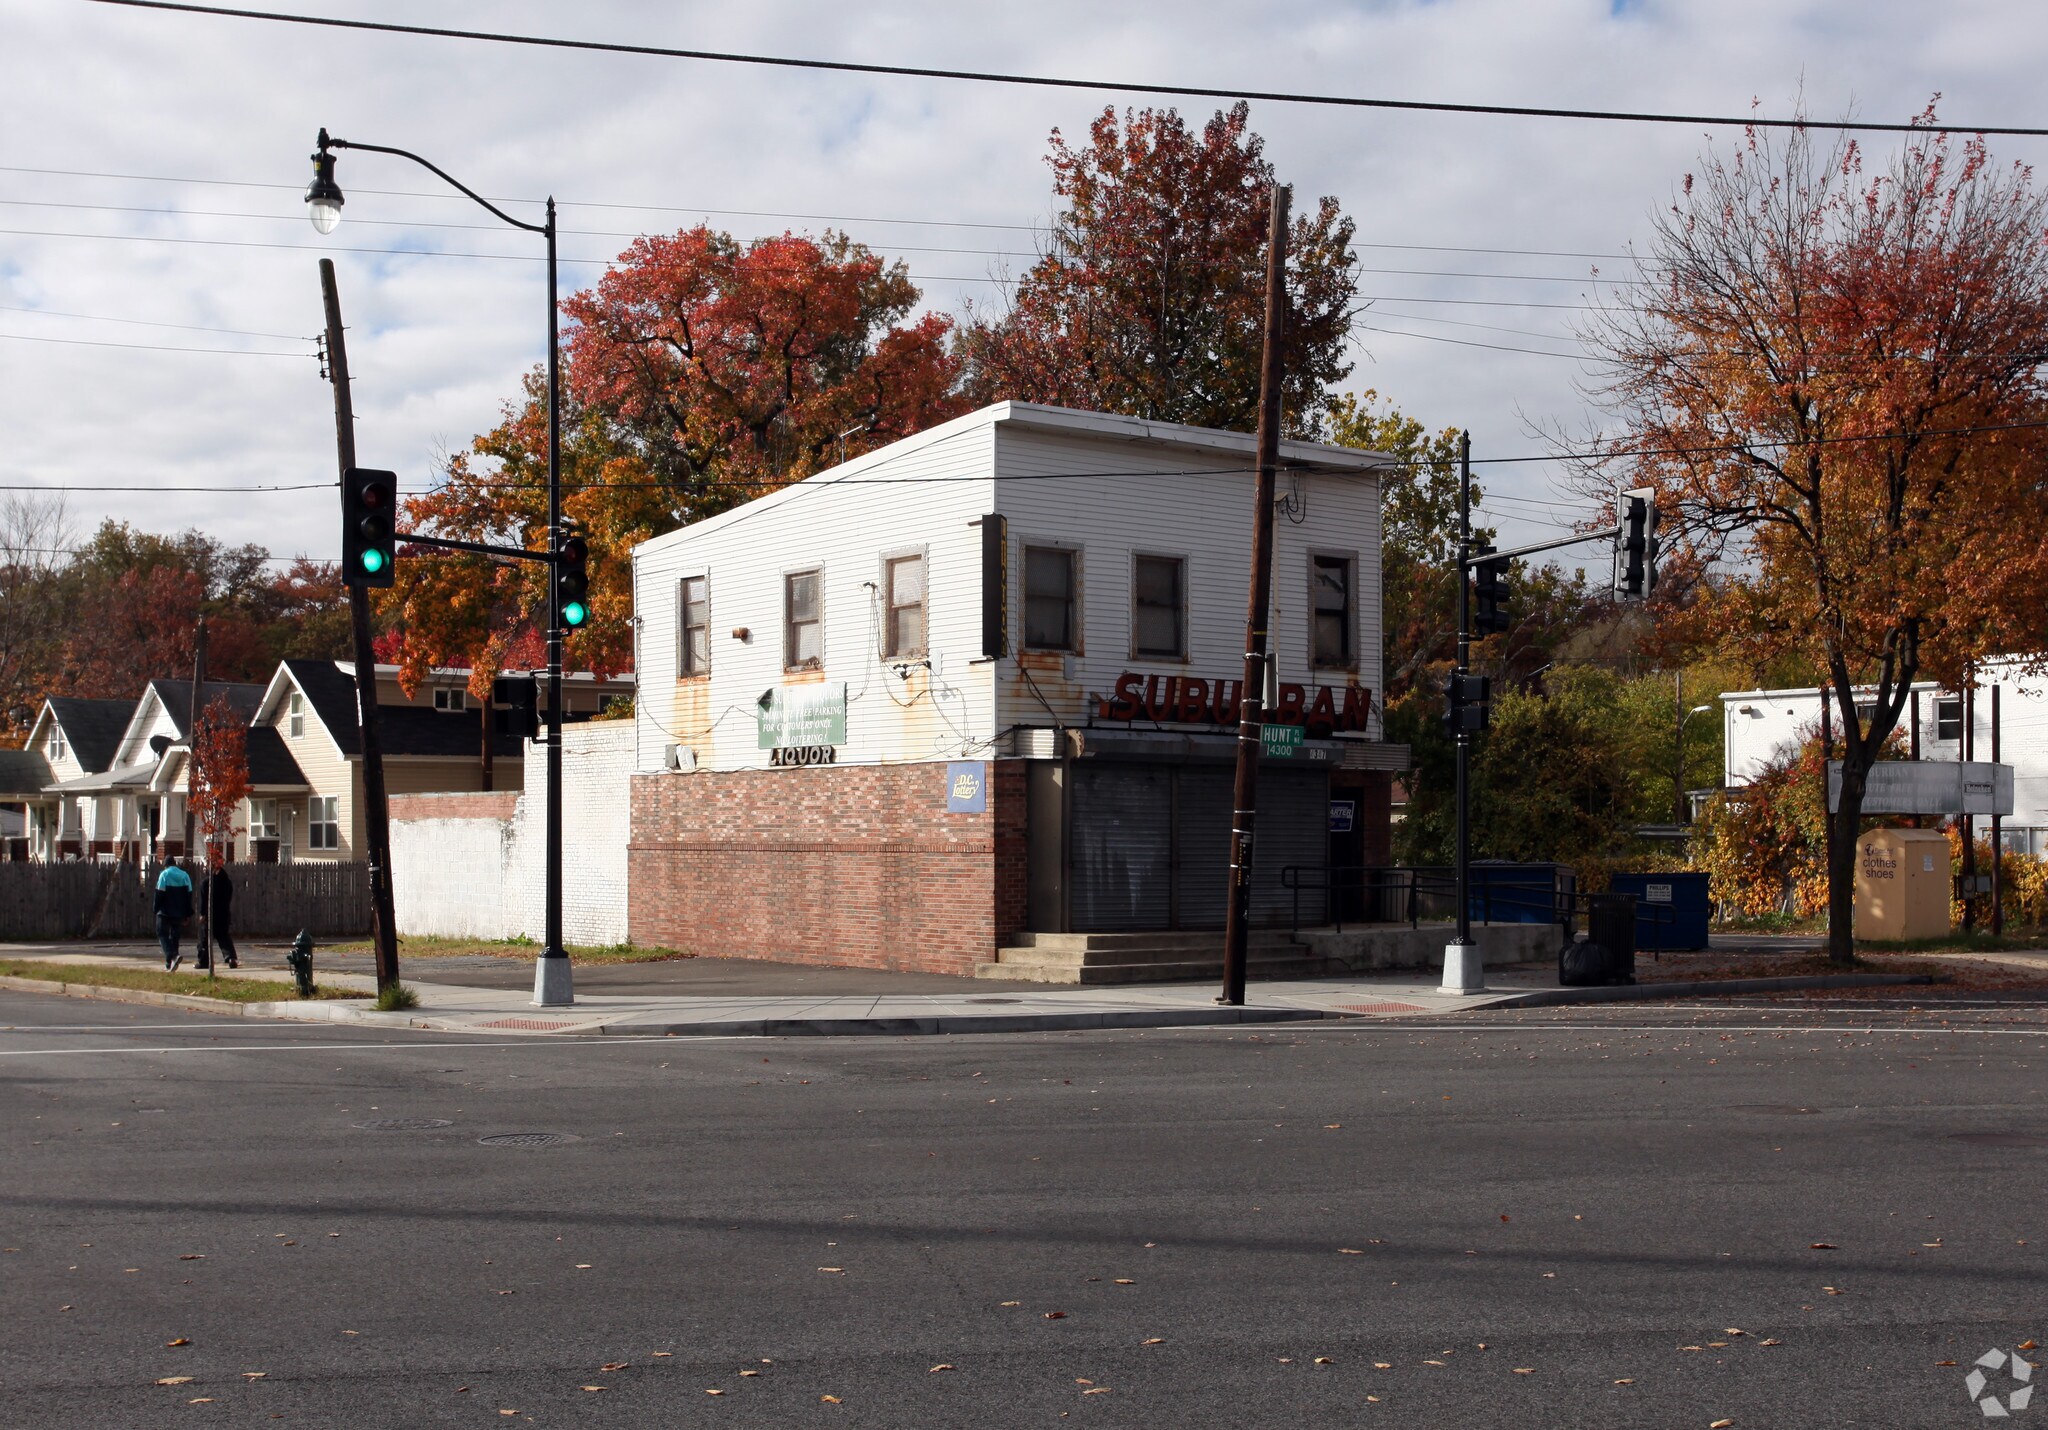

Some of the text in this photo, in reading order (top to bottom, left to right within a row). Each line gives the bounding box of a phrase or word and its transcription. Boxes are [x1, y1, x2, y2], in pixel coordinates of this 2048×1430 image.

[1115, 673, 1372, 731] SUBUBAN
[815, 705, 842, 716] PARKING
[763, 723, 774, 732] FOR
[1264, 728, 1291, 743] HUNT
[768, 746, 834, 766] LIQUOR
[1863, 857, 1897, 868] clothes
[1865, 868, 1894, 879] shoes
